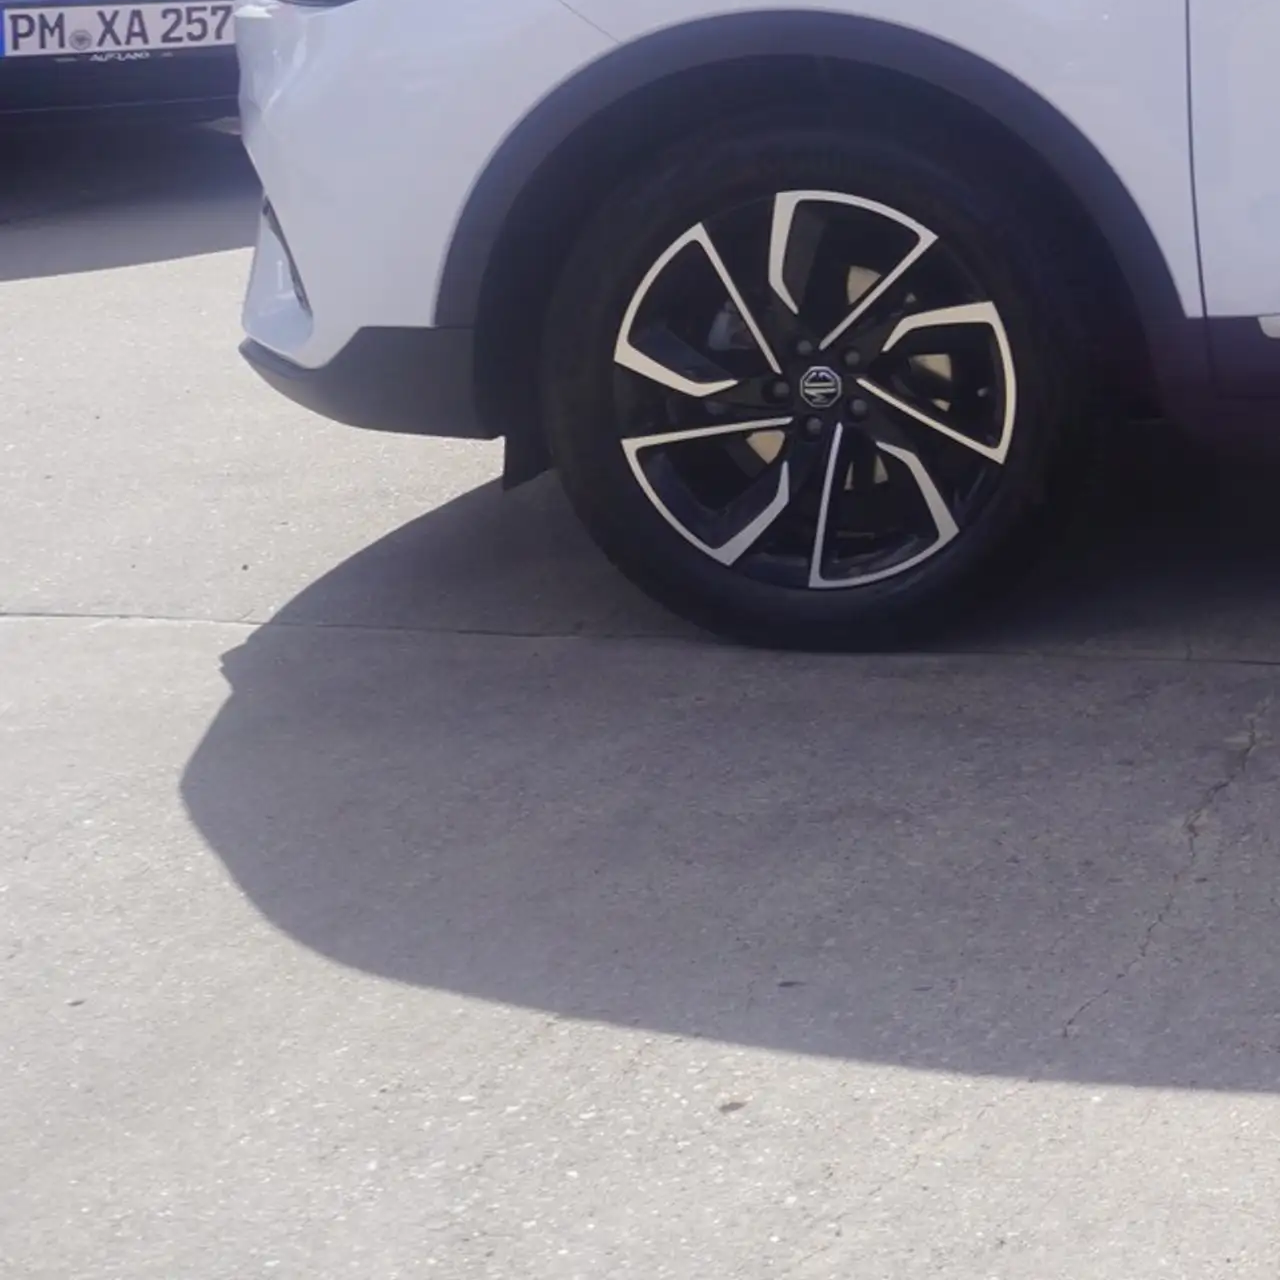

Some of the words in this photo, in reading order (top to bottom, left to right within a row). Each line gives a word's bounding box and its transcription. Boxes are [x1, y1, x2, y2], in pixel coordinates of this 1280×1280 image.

[9, 14, 66, 51] PM
[96, 9, 149, 47] XA
[160, 5, 233, 44] 257
